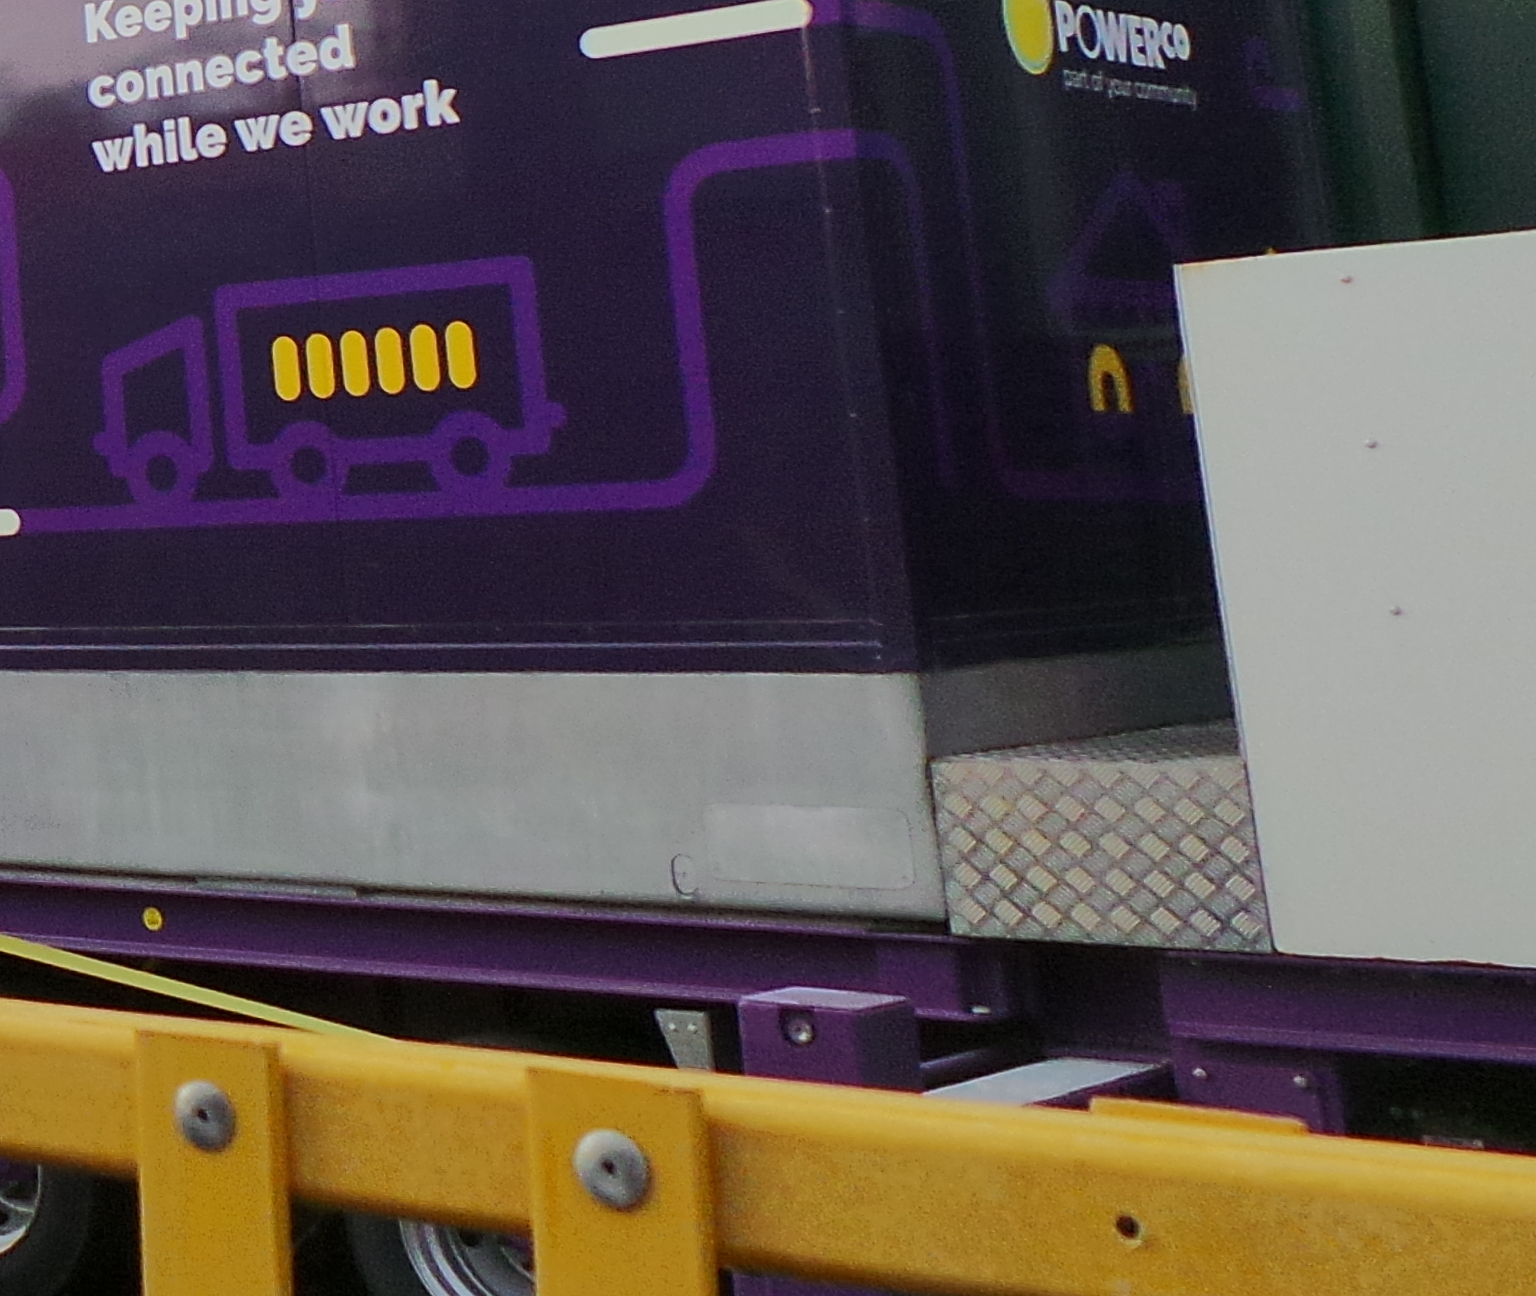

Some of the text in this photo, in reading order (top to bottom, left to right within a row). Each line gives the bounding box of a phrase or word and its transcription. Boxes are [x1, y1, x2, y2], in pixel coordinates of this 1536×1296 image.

[87, 23, 356, 108] connected
[92, 79, 461, 173] while we work
